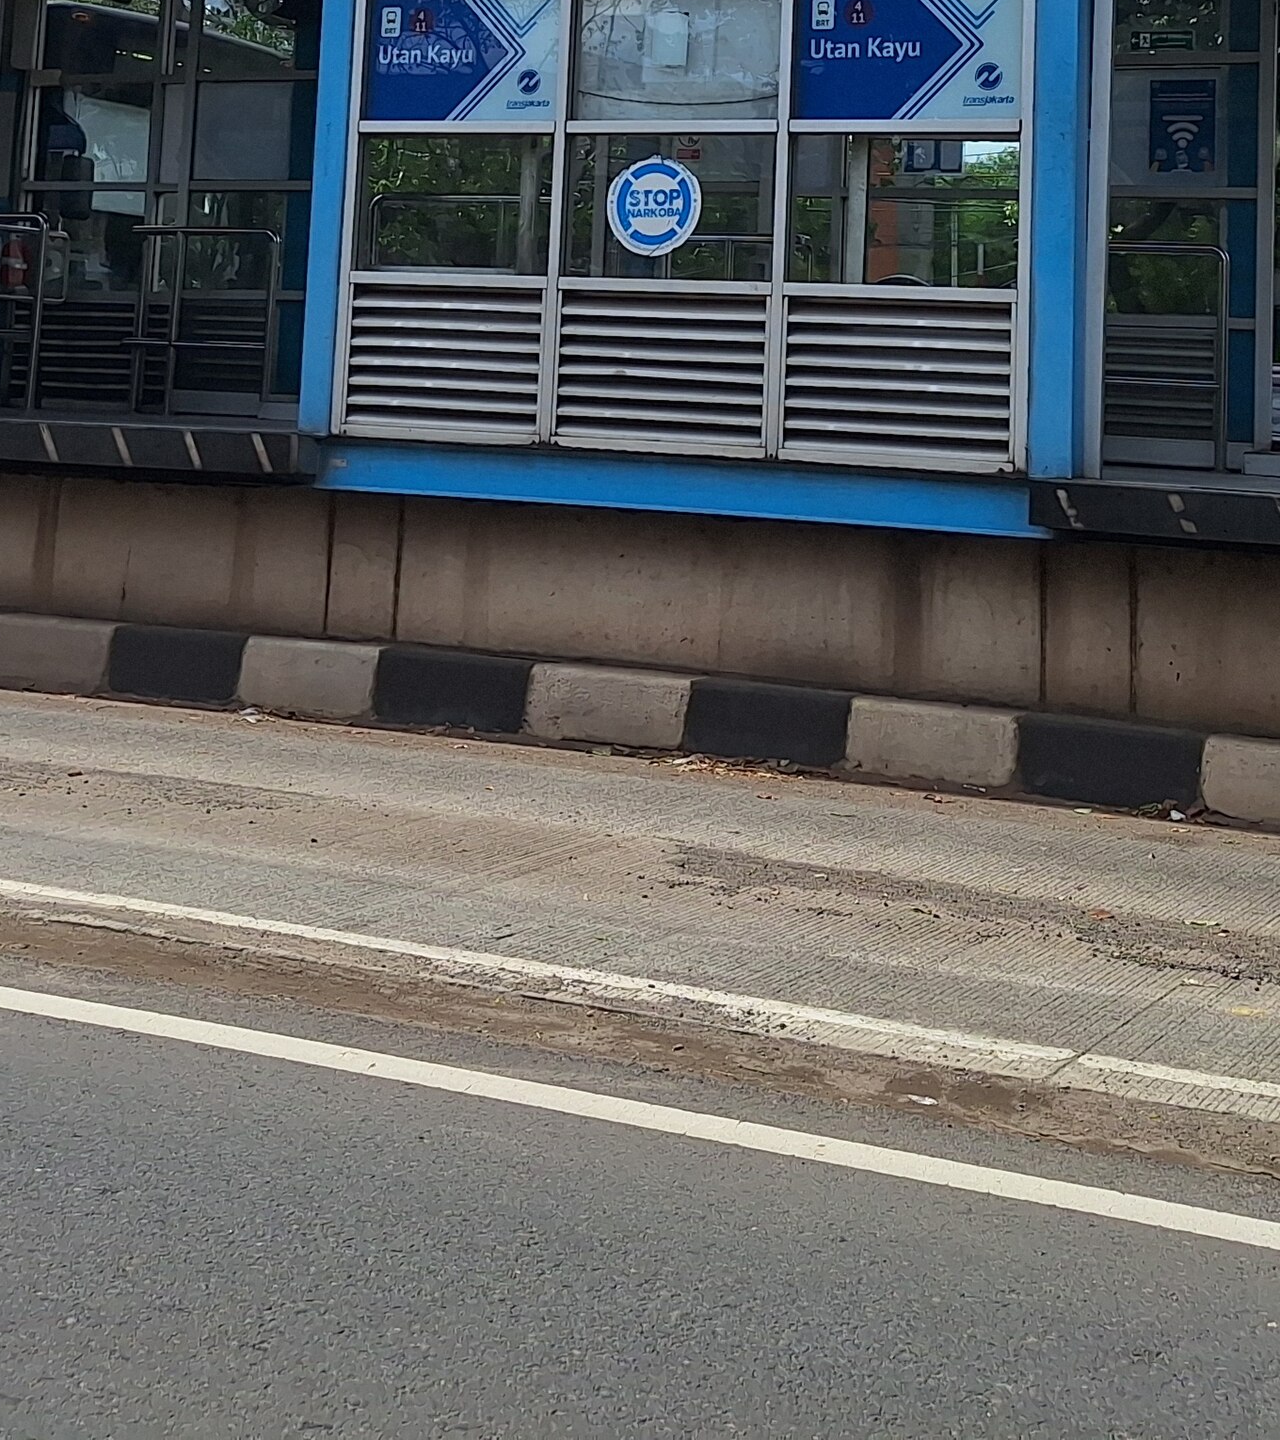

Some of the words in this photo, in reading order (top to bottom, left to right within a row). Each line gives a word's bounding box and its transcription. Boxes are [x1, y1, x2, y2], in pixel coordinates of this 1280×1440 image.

[854, 1, 862, 11] 4
[418, 11, 425, 21] 4
[851, 13, 865, 23] 11
[415, 22, 427, 32] 11
[815, 19, 830, 27] BRT
[810, 39, 860, 58] Utan
[867, 38, 920, 62] Kayu
[379, 46, 421, 64] Utan
[427, 45, 473, 69] Kayu
[963, 95, 1015, 106] transjakarta
[628, 189, 681, 208] STOP
[627, 208, 681, 218] NARKOBA
